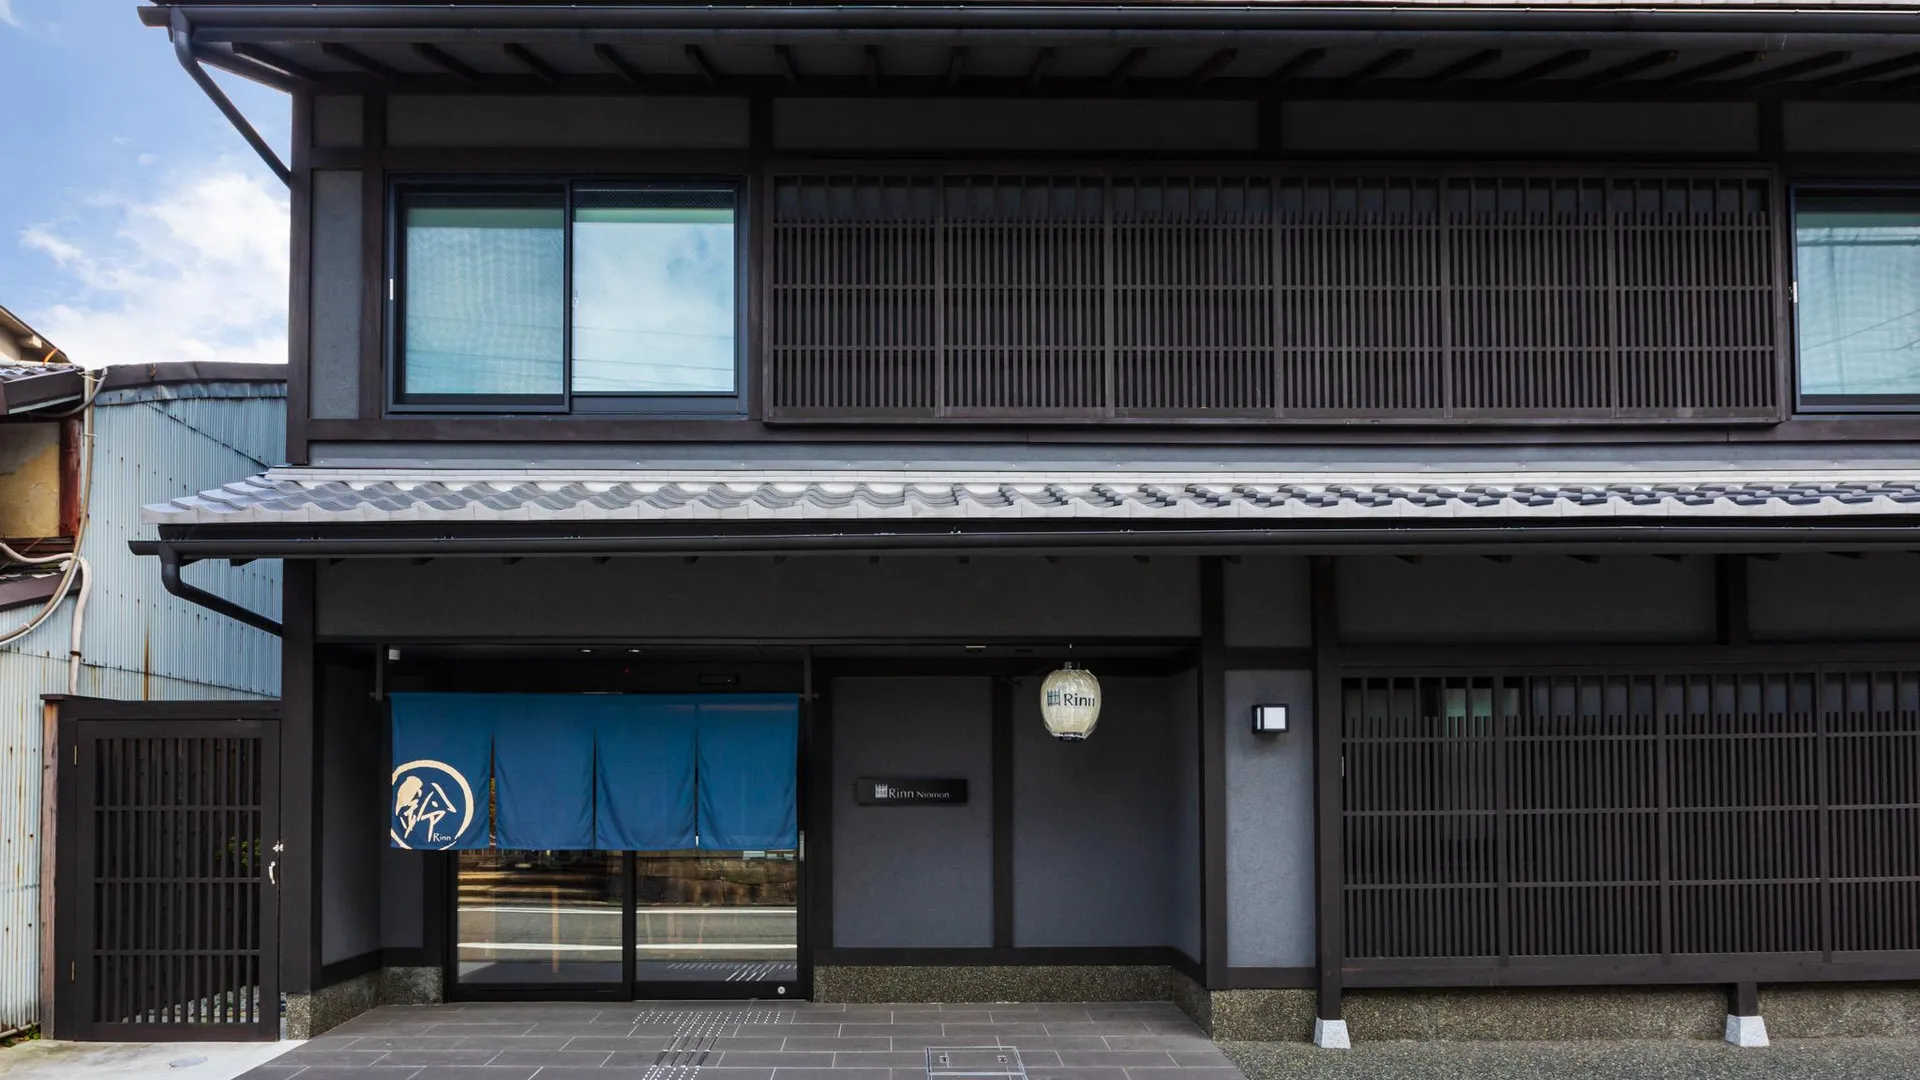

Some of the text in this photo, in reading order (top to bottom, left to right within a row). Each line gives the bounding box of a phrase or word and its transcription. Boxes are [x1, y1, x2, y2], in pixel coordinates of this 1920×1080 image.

[1063, 693, 1095, 707] Rinn
[888, 788, 914, 798] Rinn
[433, 832, 451, 842] Rinn
